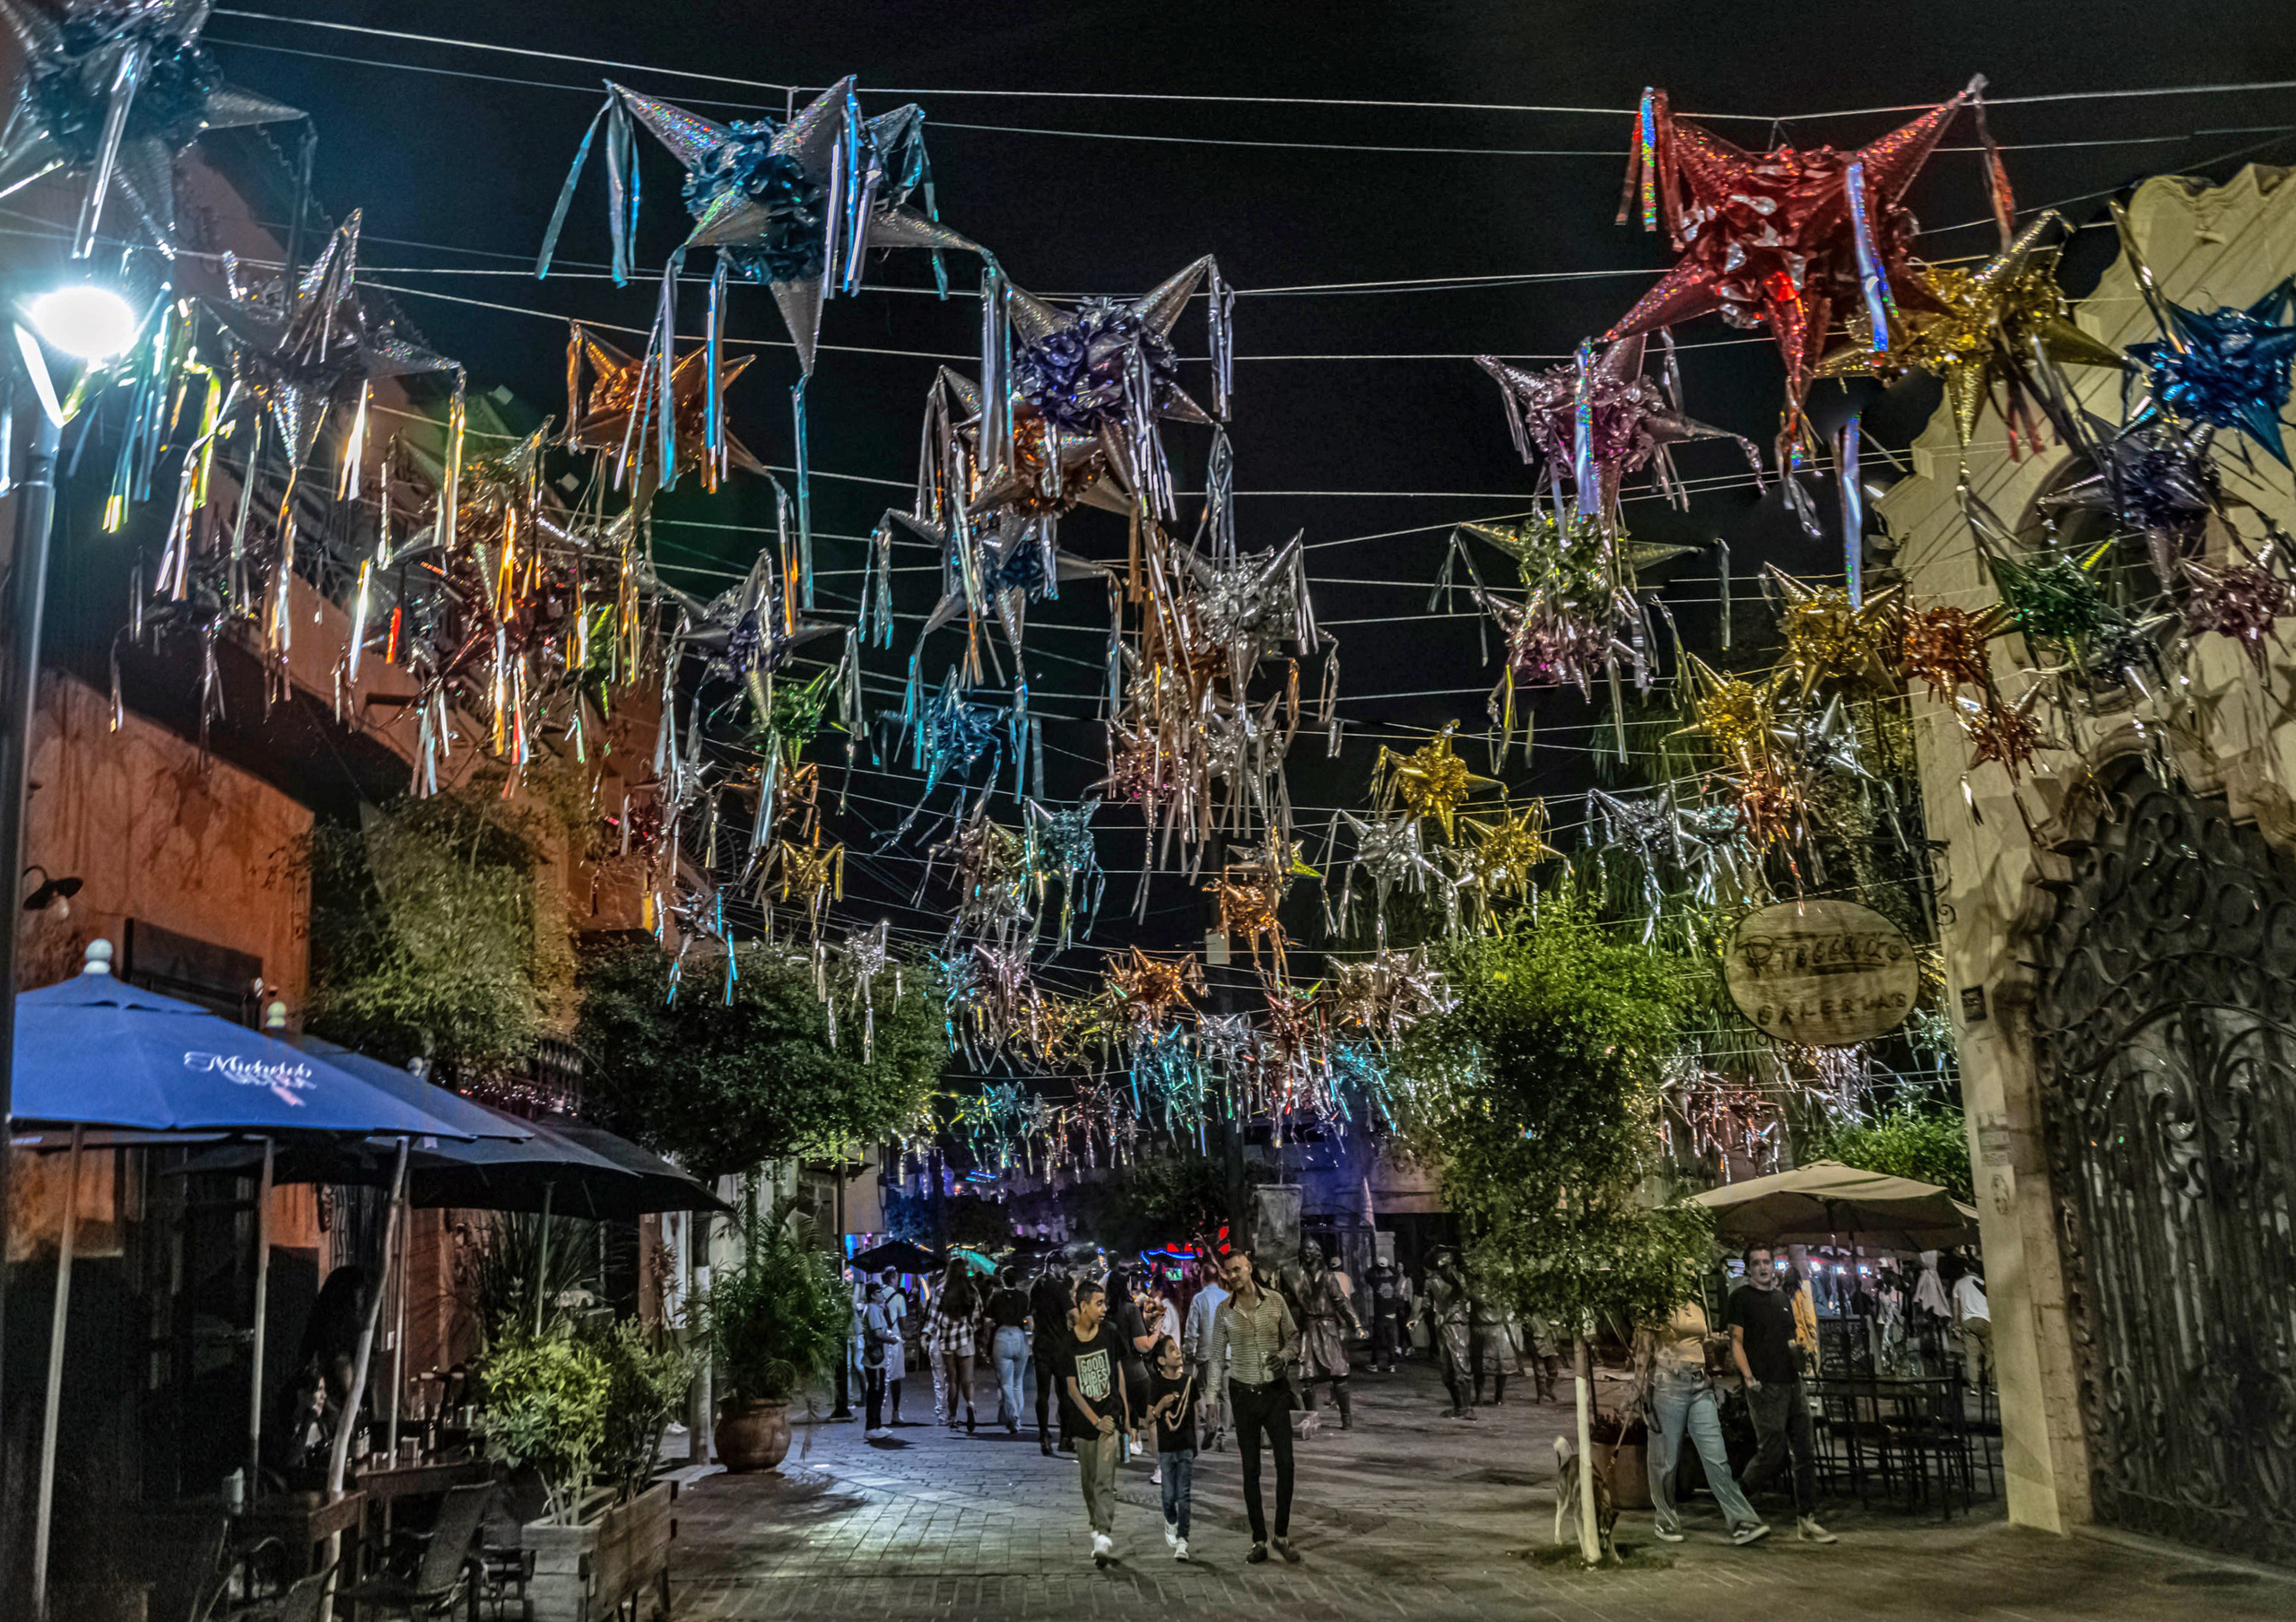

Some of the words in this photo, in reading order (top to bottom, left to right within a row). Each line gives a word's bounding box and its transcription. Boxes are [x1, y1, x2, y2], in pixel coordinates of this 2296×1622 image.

[1081, 1356, 1104, 1373] GOOD
[1082, 1368, 1109, 1385] VIBES
[1086, 1382, 1108, 1397] ONLY
